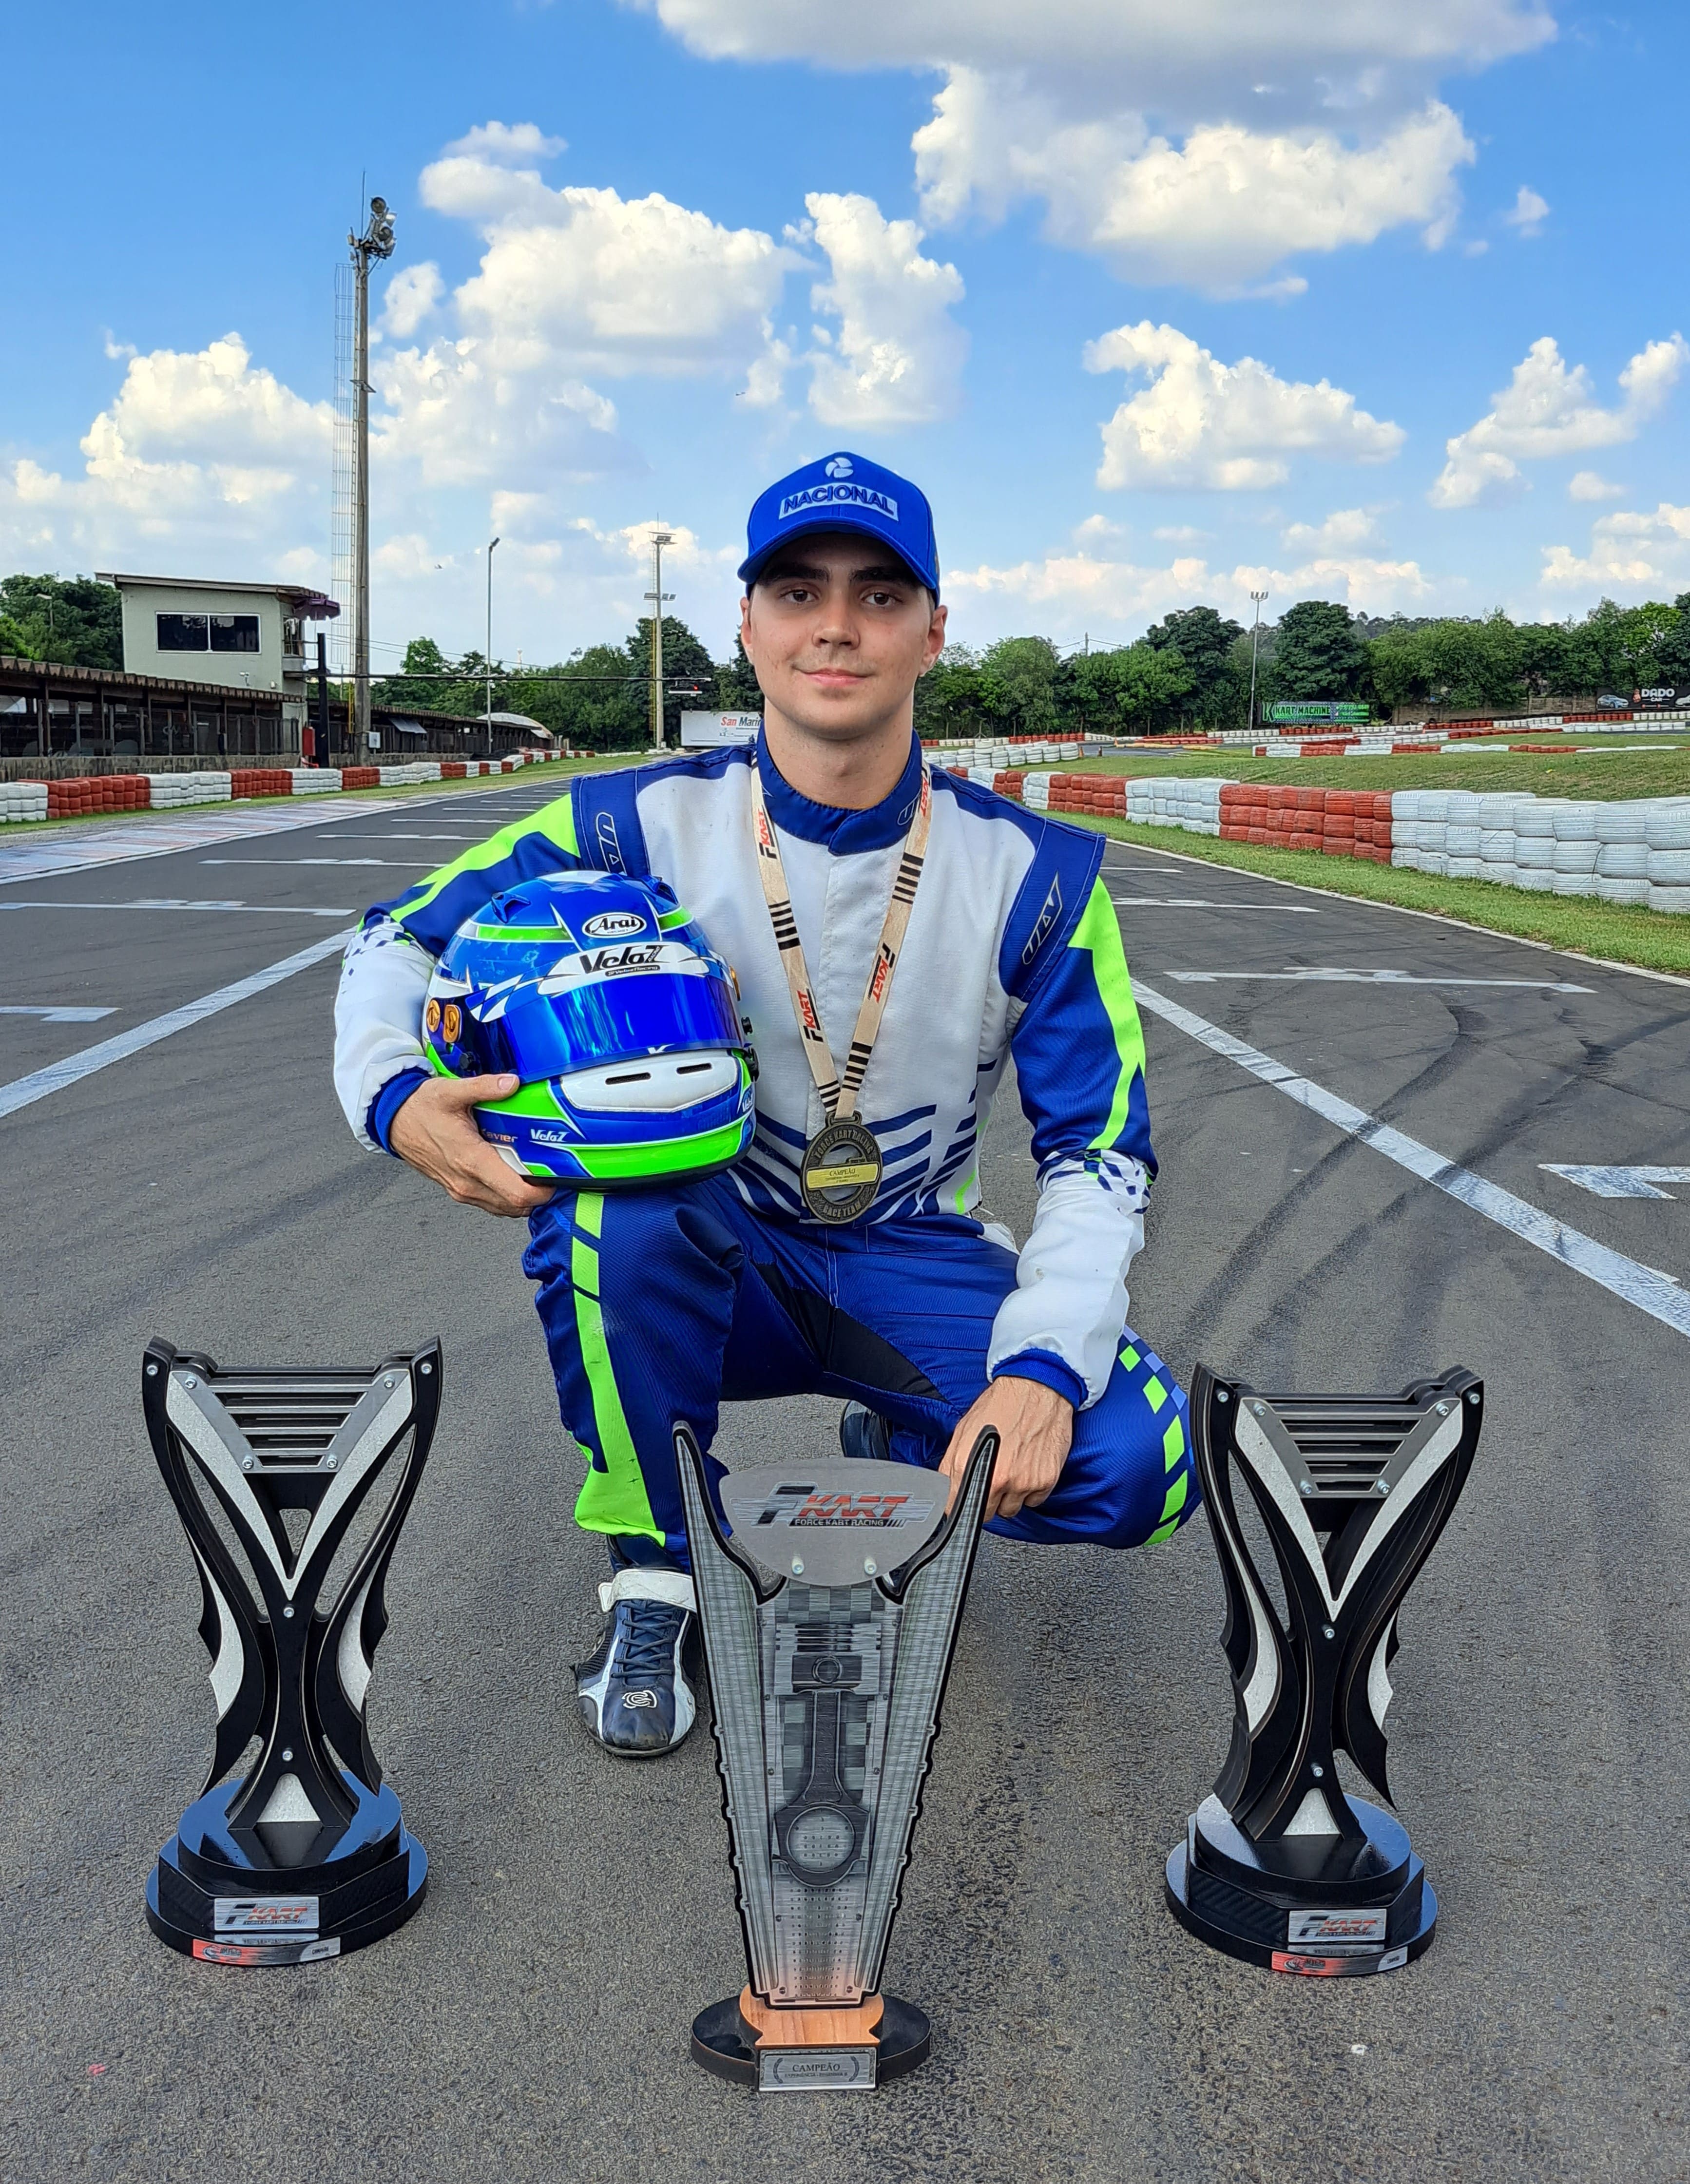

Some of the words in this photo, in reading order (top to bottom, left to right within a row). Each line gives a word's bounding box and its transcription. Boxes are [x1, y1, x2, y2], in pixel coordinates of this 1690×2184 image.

[783, 485, 894, 516] NACIONAL
[1641, 688, 1675, 697] DADO
[1275, 706, 1295, 715] KART
[1298, 706, 1330, 715] MACHINE
[721, 716, 737, 727] San
[590, 917, 638, 934] Arai
[833, 1129, 852, 1141] KART
[852, 1130, 874, 1154] RACING
[823, 1204, 841, 1218] RACE
[842, 1200, 862, 1218] TEAM
[792, 2063, 841, 2072] CAMPEÃO
